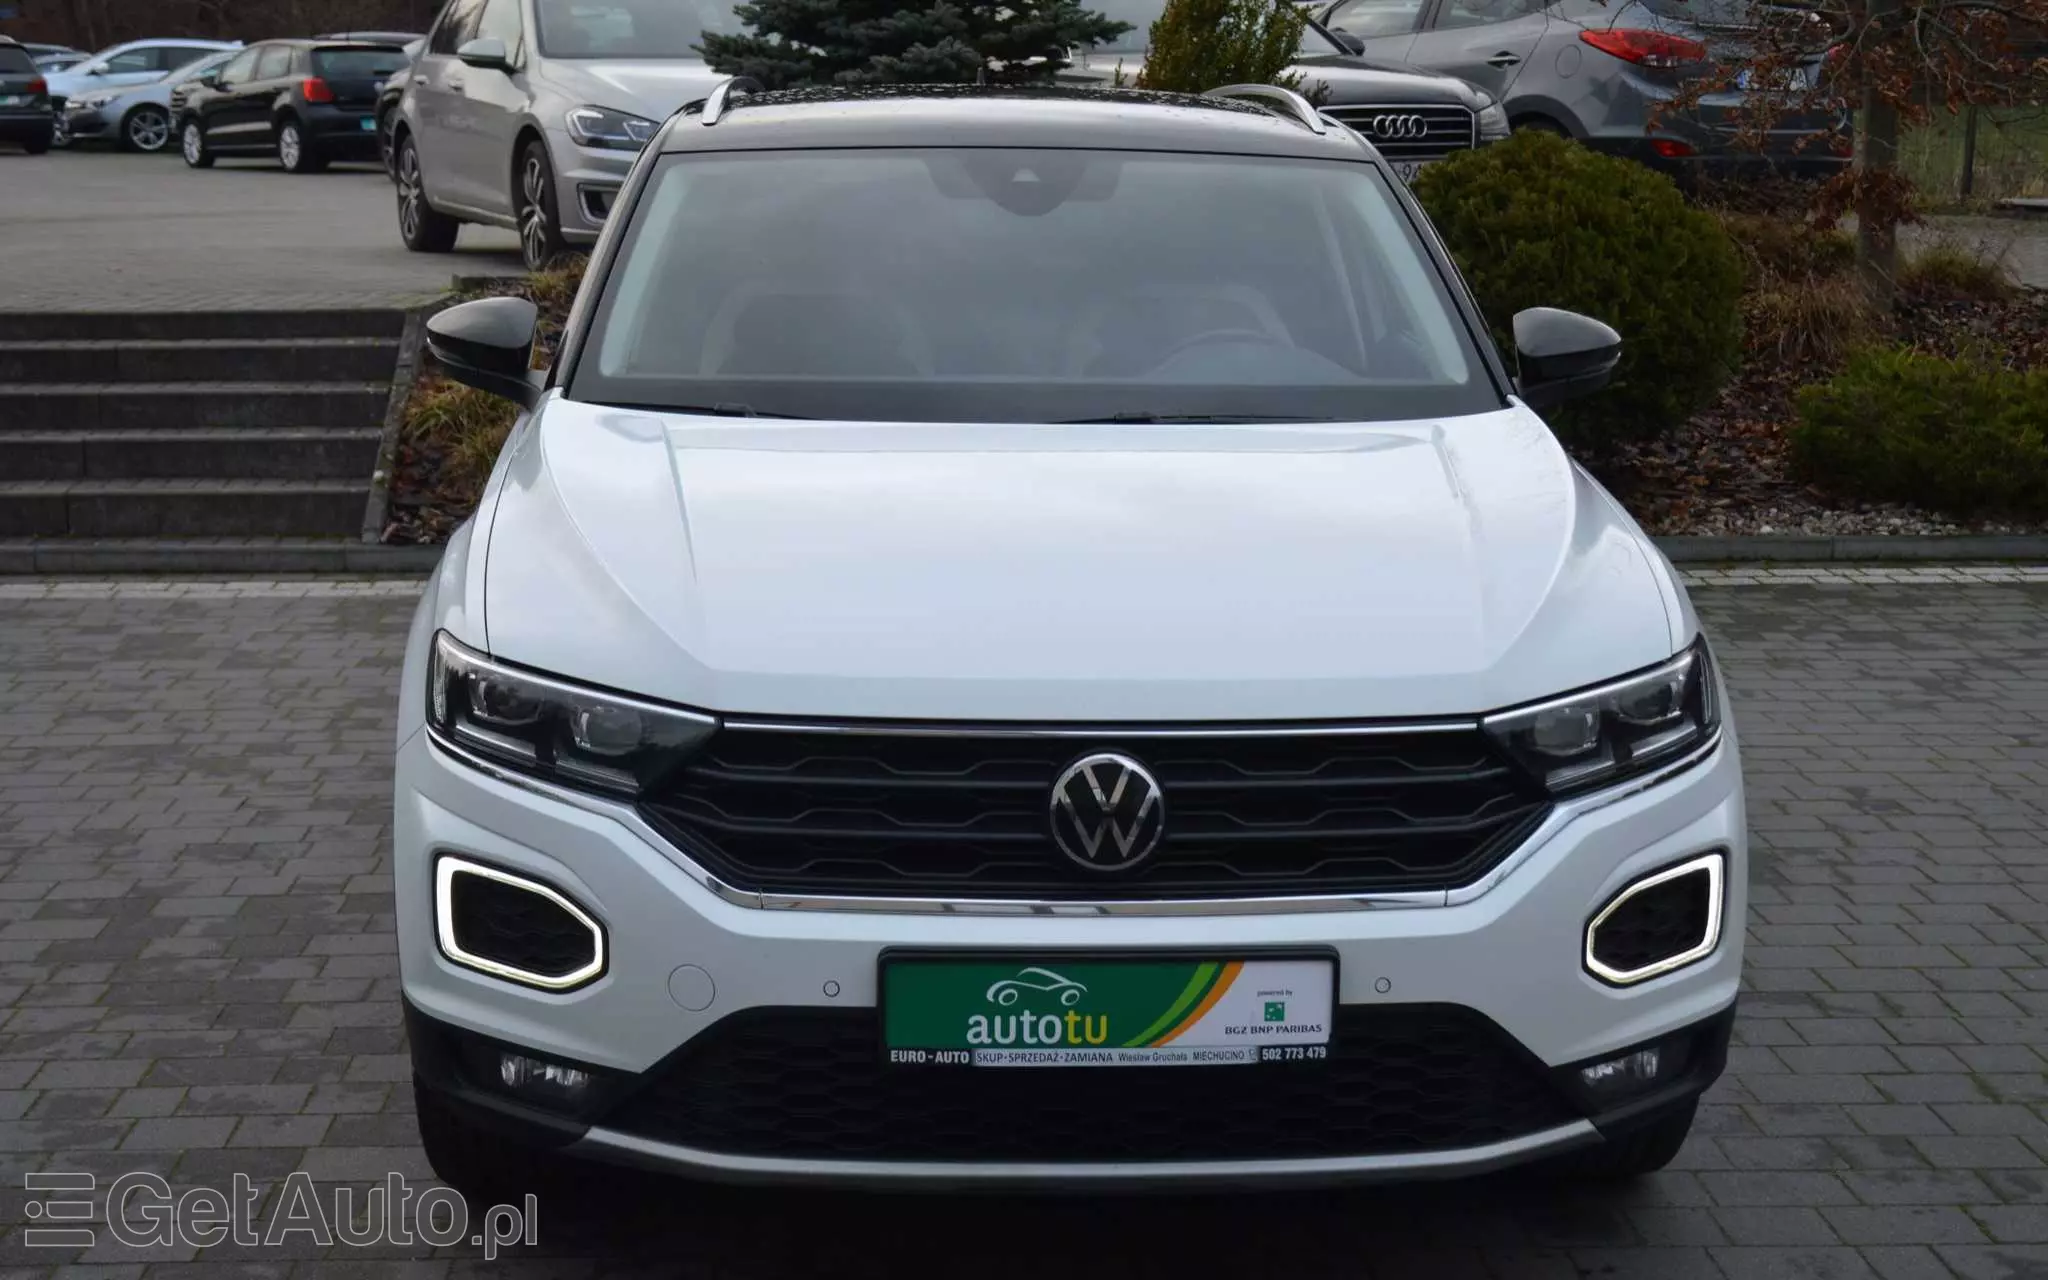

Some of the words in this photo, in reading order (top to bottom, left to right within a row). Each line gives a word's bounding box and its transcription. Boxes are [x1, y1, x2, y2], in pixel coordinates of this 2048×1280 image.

[1257, 989, 1284, 997] powered
[1285, 989, 1293, 997] by
[966, 1010, 1107, 1044] autotu
[1250, 1025, 1274, 1034] BNP
[1276, 1024, 1322, 1034] PARIBAS
[1262, 1047, 1282, 1060] 502
[1285, 1046, 1304, 1060] 773
[1306, 1046, 1327, 1059] 479
